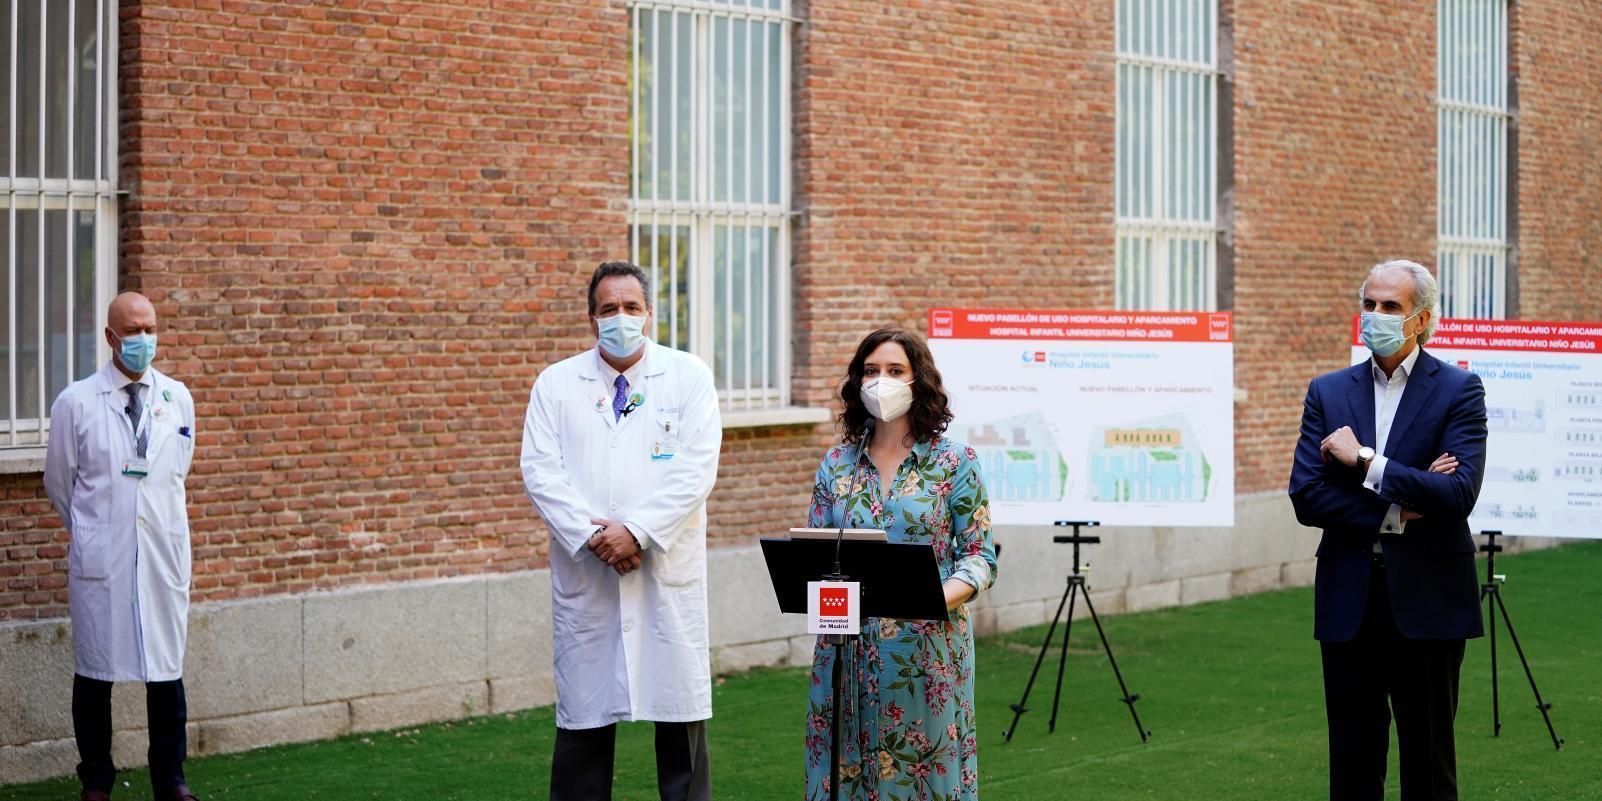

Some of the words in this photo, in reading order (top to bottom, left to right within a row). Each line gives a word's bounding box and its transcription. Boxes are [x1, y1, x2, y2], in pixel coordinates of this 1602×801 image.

[967, 314, 995, 322] NUEVO
[996, 313, 1038, 323] PABELLÓN
[1039, 315, 1050, 323] DE
[1051, 315, 1069, 324] USO
[1070, 315, 1127, 324] HOSPITALARIO
[1127, 316, 1134, 324] Y
[1135, 316, 1197, 325] APARCAMIENTO
[990, 327, 1028, 336] HOSPITAL
[1030, 328, 1065, 336] INFANTIL
[1066, 328, 1125, 337] UNIVERSITARIO
[1126, 328, 1147, 337] NIÑO
[1148, 328, 1173, 338] JESÚS
[1463, 324, 1474, 332] DE
[1475, 324, 1492, 333] USO
[1493, 325, 1550, 334] HOSPITALARIO
[1551, 327, 1557, 335] Y
[1453, 337, 1488, 346] INFANTIL
[1489, 338, 1548, 347] UNIVERSITARIO
[1549, 339, 1569, 348] NIÑO
[1570, 340, 1595, 349] JESÚS
[1049, 360, 1074, 369] Niño
[1078, 360, 1110, 369] Jesús
[1472, 360, 1503, 369] Hospital
[1532, 362, 1581, 370] Universitario
[1500, 369, 1531, 379] Jesús
